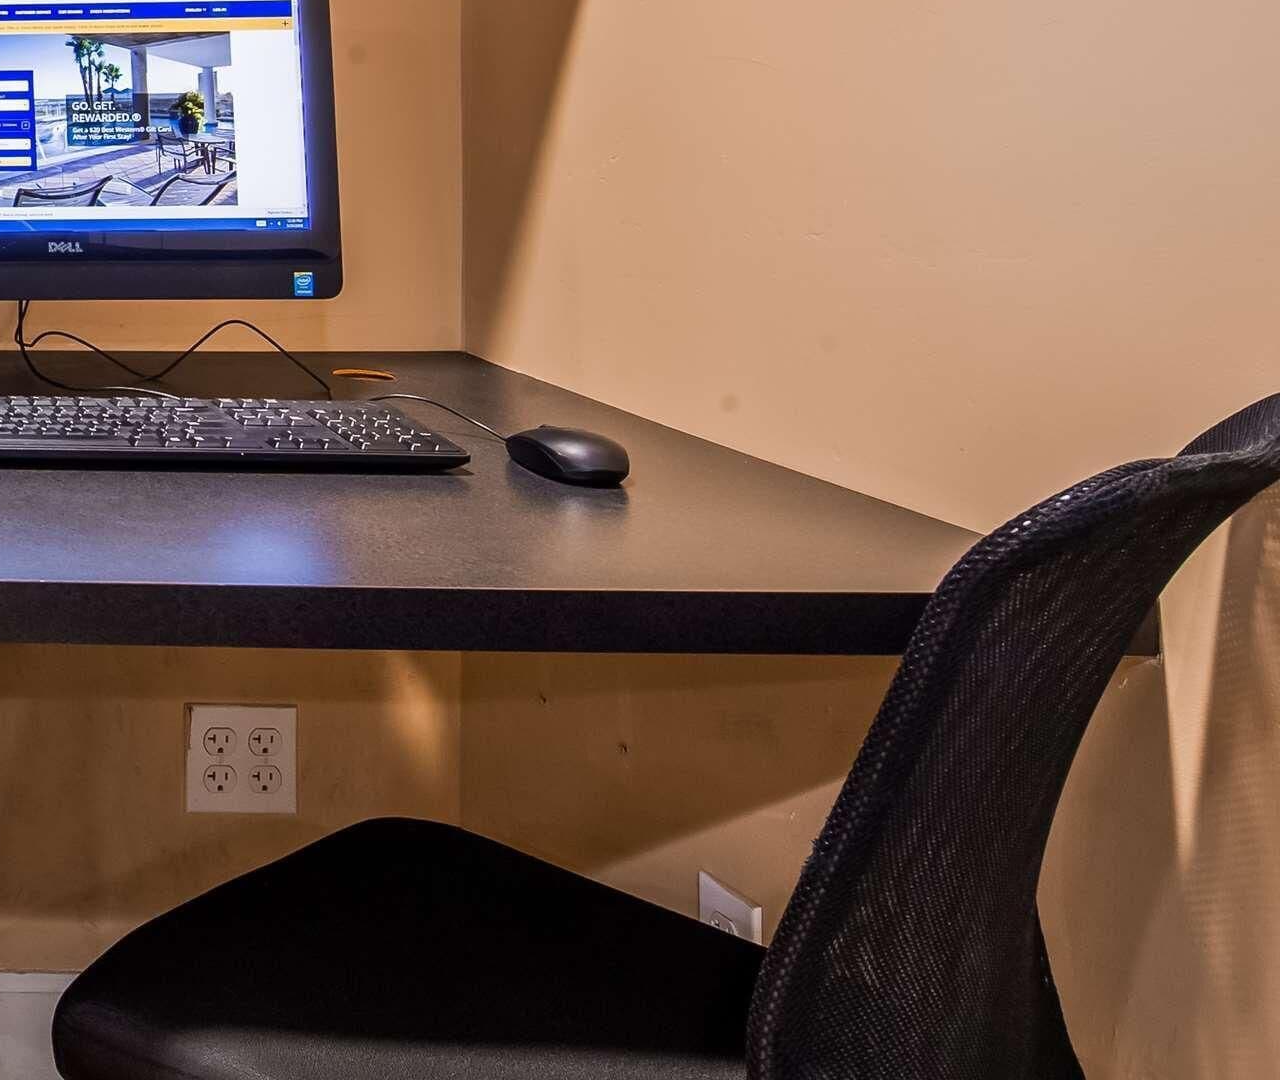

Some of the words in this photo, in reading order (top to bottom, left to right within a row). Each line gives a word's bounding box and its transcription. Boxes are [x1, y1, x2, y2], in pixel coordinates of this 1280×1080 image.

[71, 102, 91, 111] GO.
[93, 101, 116, 111] GET.
[48, 241, 83, 253] DELL
